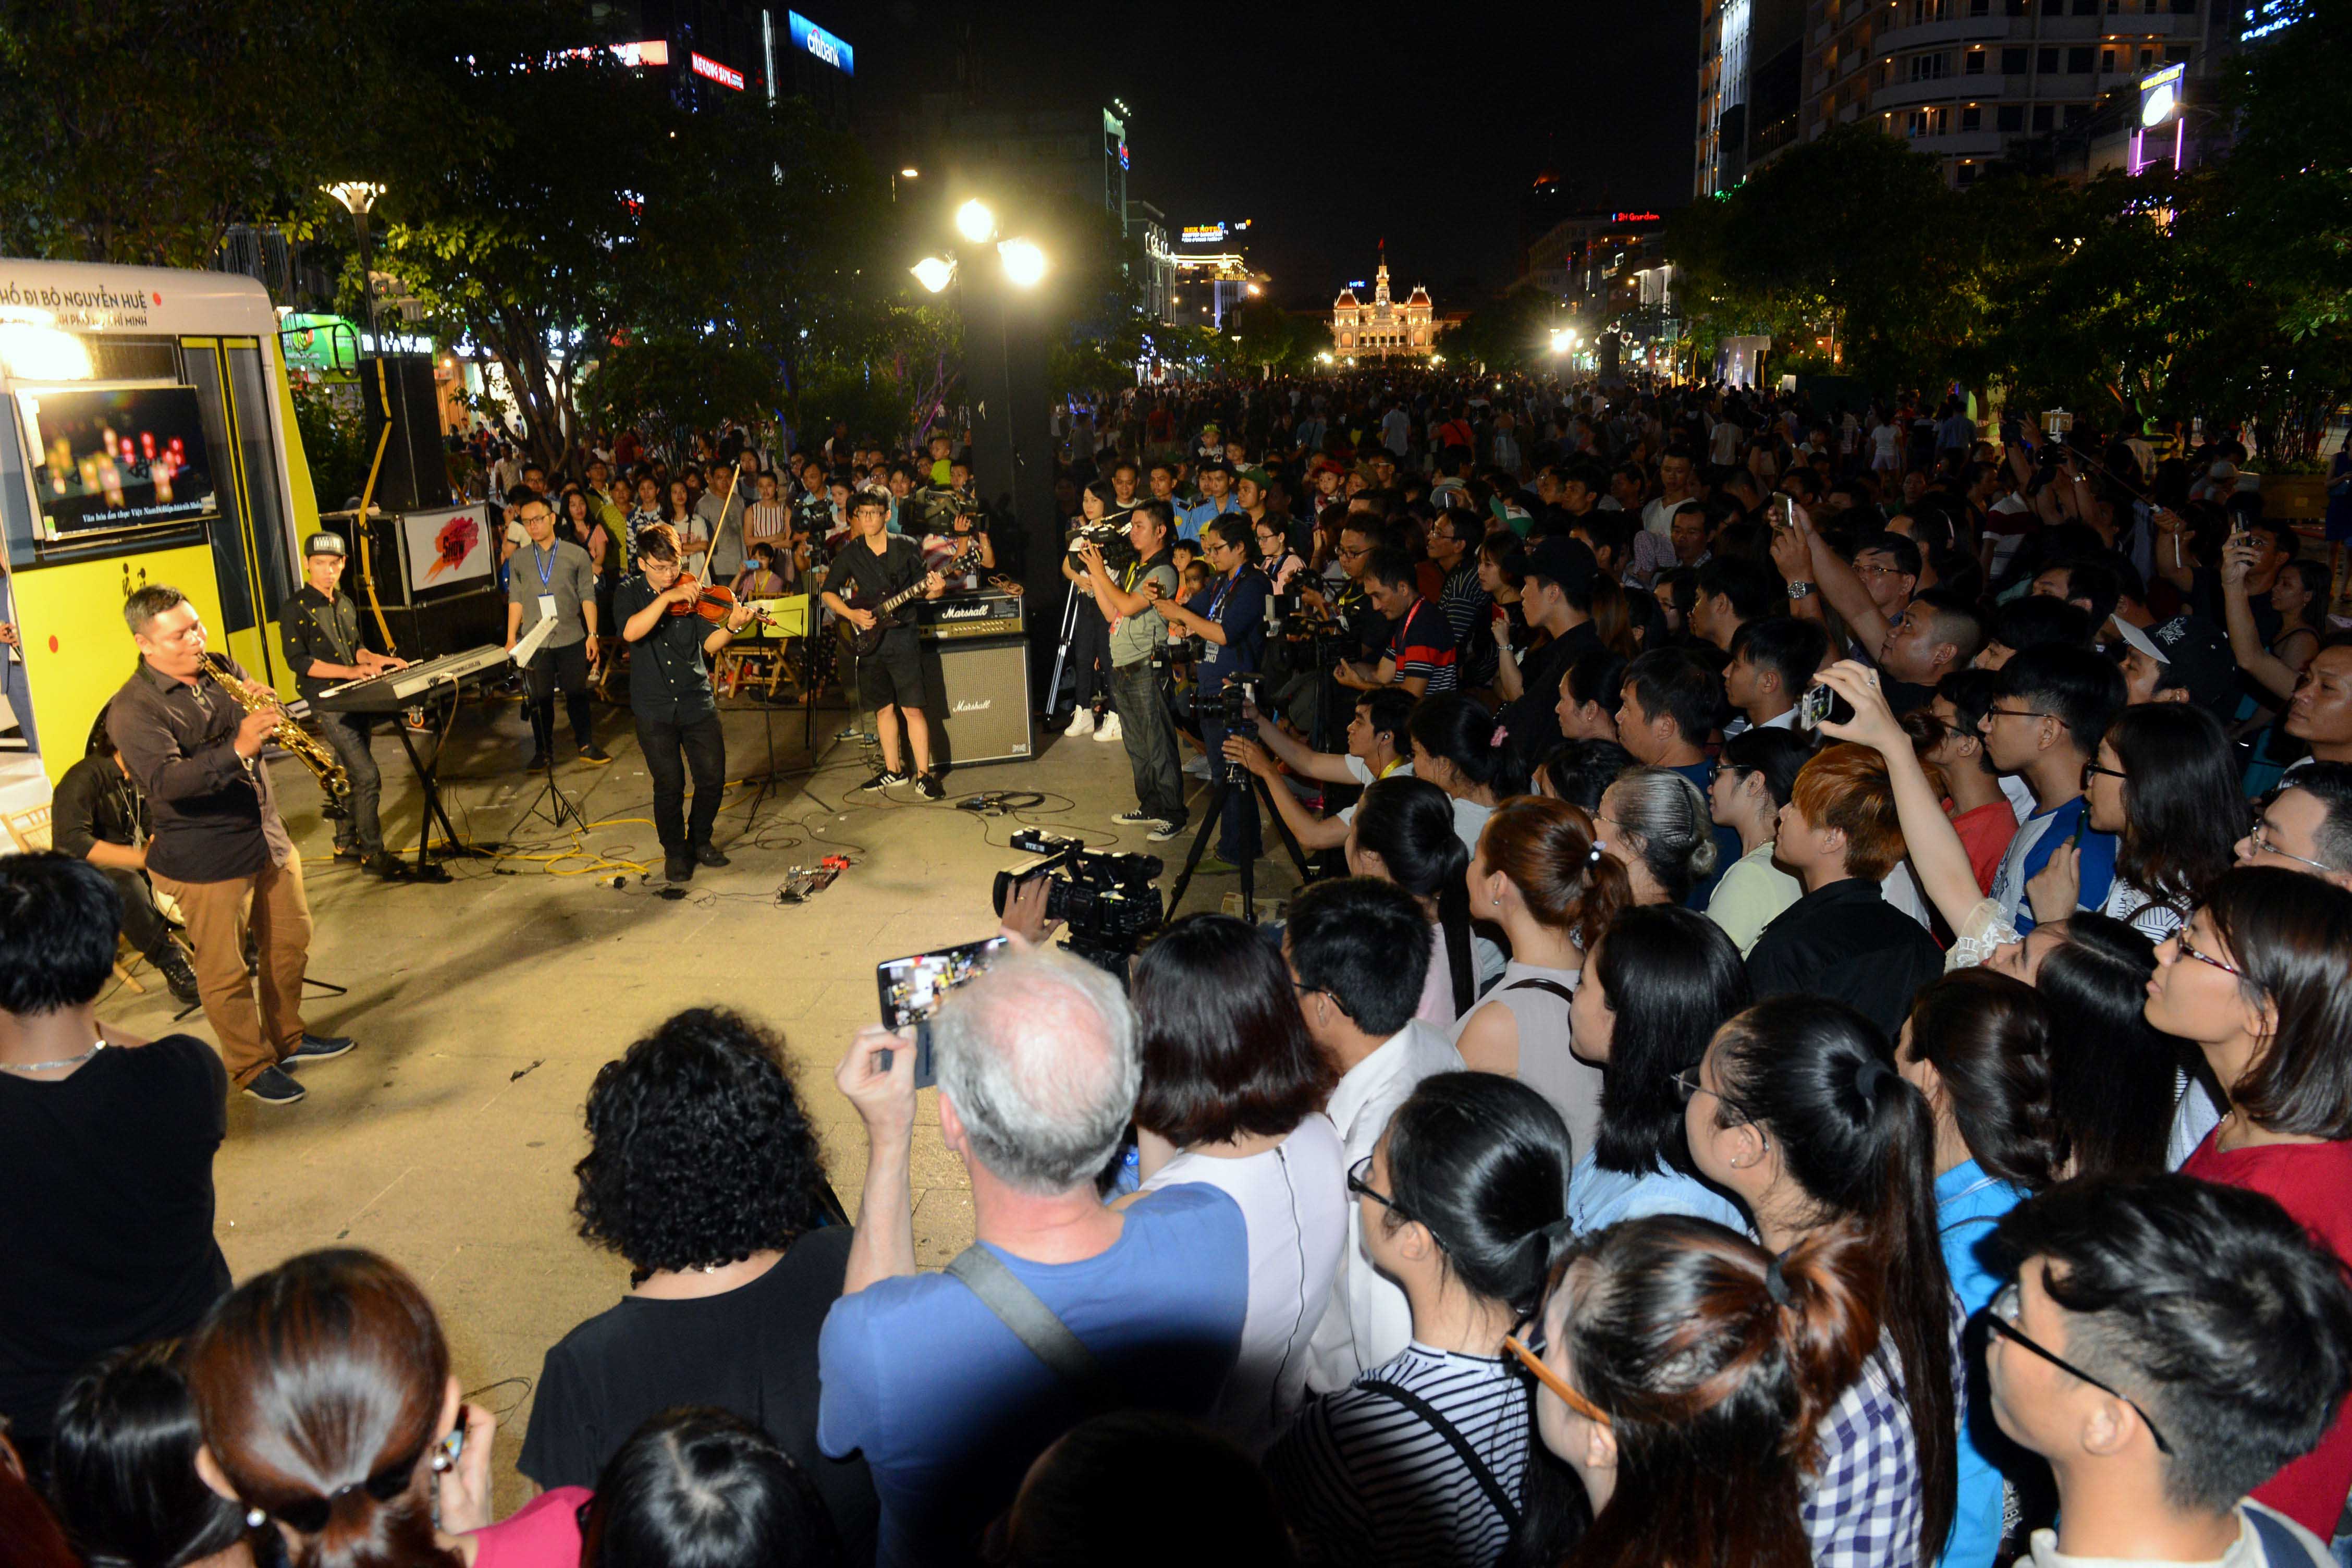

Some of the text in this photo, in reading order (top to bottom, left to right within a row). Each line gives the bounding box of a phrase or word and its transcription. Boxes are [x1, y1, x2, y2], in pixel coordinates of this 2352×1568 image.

[807, 32, 840, 68] citibank
[692, 54, 718, 80] MEKONG
[719, 67, 731, 84] SUN
[1629, 211, 1660, 222] Garden
[23, 289, 39, 305] ĐI
[41, 286, 61, 311] BỘ
[63, 284, 119, 308] NGUYỄN
[120, 290, 148, 314] HUỆ
[125, 315, 148, 326] MINH
[942, 604, 989, 619] Marshall
[953, 700, 991, 713] Marshall
